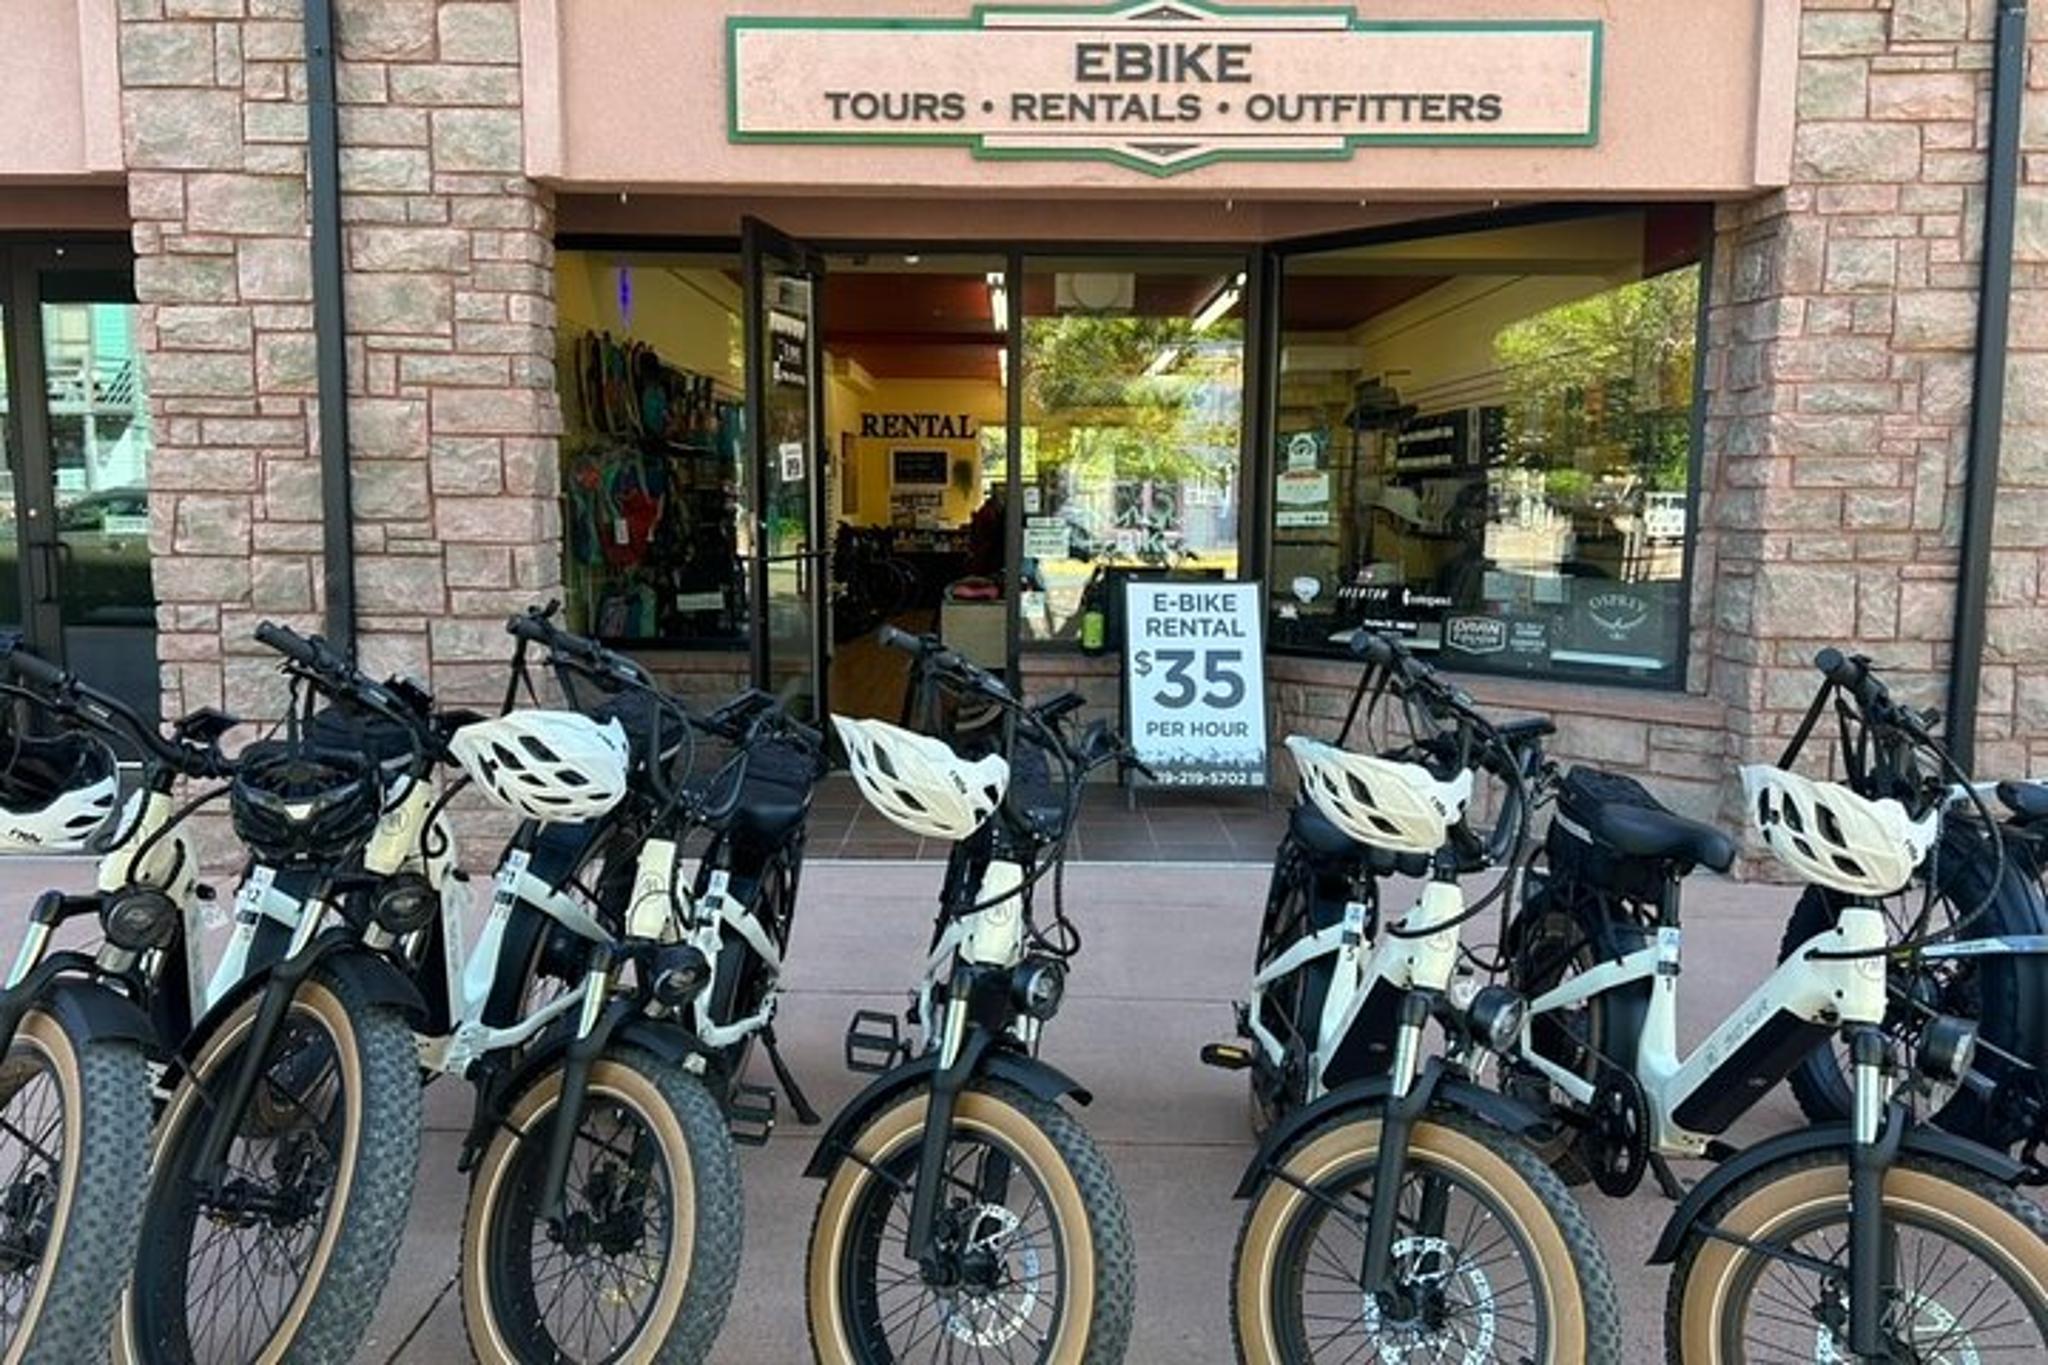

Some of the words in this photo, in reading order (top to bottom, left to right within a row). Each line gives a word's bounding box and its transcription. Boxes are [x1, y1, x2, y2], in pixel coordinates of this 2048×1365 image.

[1075, 43, 1252, 83] EBIKE
[824, 92, 966, 122] TOURS
[1010, 93, 1202, 123] RENTALS
[1245, 94, 1503, 123] OUTFITTERS
[861, 412, 977, 438] RENTAL
[1153, 593, 1237, 613] E-BIKE
[1146, 618, 1246, 638] RENTAL
[1134, 650, 1246, 709] $35
[1146, 722, 1184, 737] PER
[1191, 722, 1249, 738] HOUR
[1149, 770, 1247, 785] 19-219-5702
